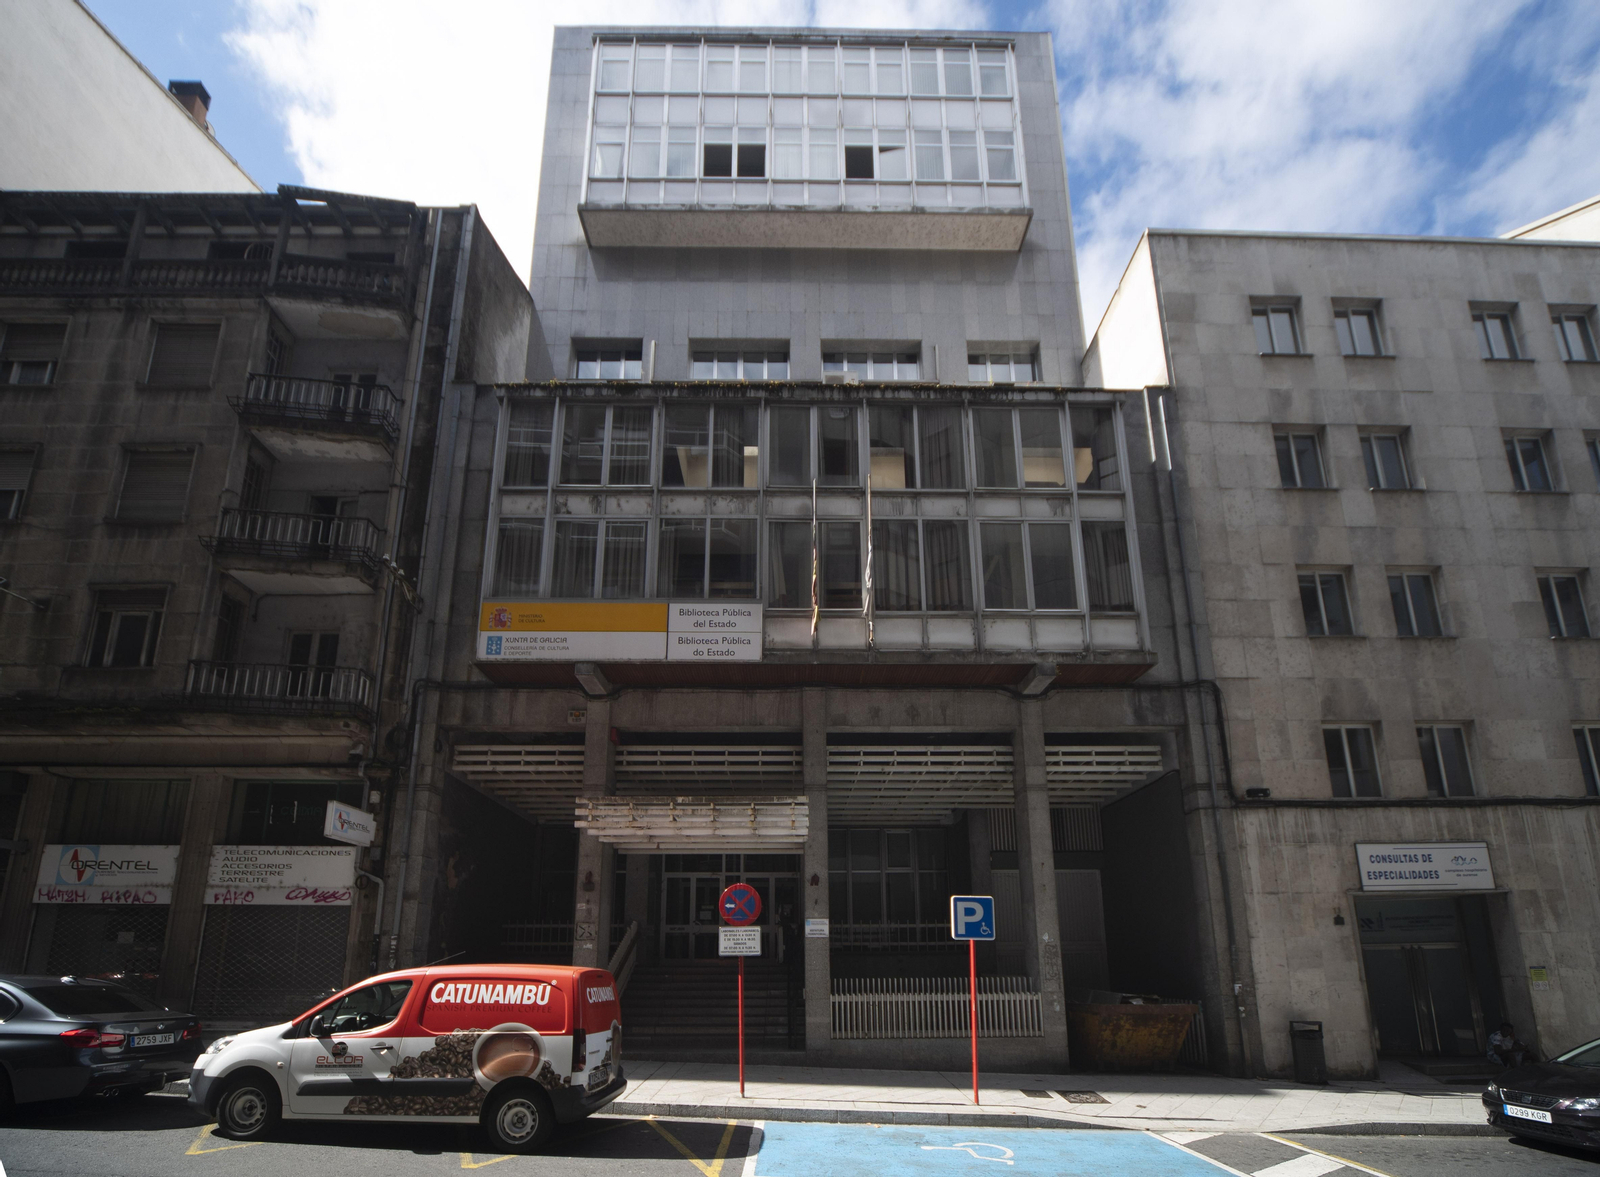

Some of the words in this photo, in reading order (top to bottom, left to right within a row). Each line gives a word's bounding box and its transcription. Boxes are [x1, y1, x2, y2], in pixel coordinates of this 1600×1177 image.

[679, 608, 720, 617] Biblioteca
[722, 608, 752, 617] Pública
[693, 620, 706, 628] del
[708, 619, 737, 628] Estado
[678, 636, 719, 645] Biblioteca
[722, 636, 751, 645] Pública
[693, 648, 705, 656] do
[707, 648, 736, 657] Estado
[338, 817, 370, 831] ORENTEL
[1369, 854, 1419, 864] CONSULTAS
[1422, 853, 1433, 863] DE
[71, 860, 159, 871] ORENTEL
[1367, 870, 1440, 880] ESPECIALIDADES
[956, 901, 985, 935] P
[430, 982, 552, 1006] CATUNAMBÚ
[426, 1004, 466, 1012] SPANISH
[469, 1005, 514, 1013] PREMIUM
[517, 1005, 552, 1013] COFFEE
[136, 1035, 157, 1045] 2759
[158, 1034, 172, 1043] JXF
[1509, 1106, 1529, 1118] 0299
[1530, 1110, 1548, 1121] KGR
